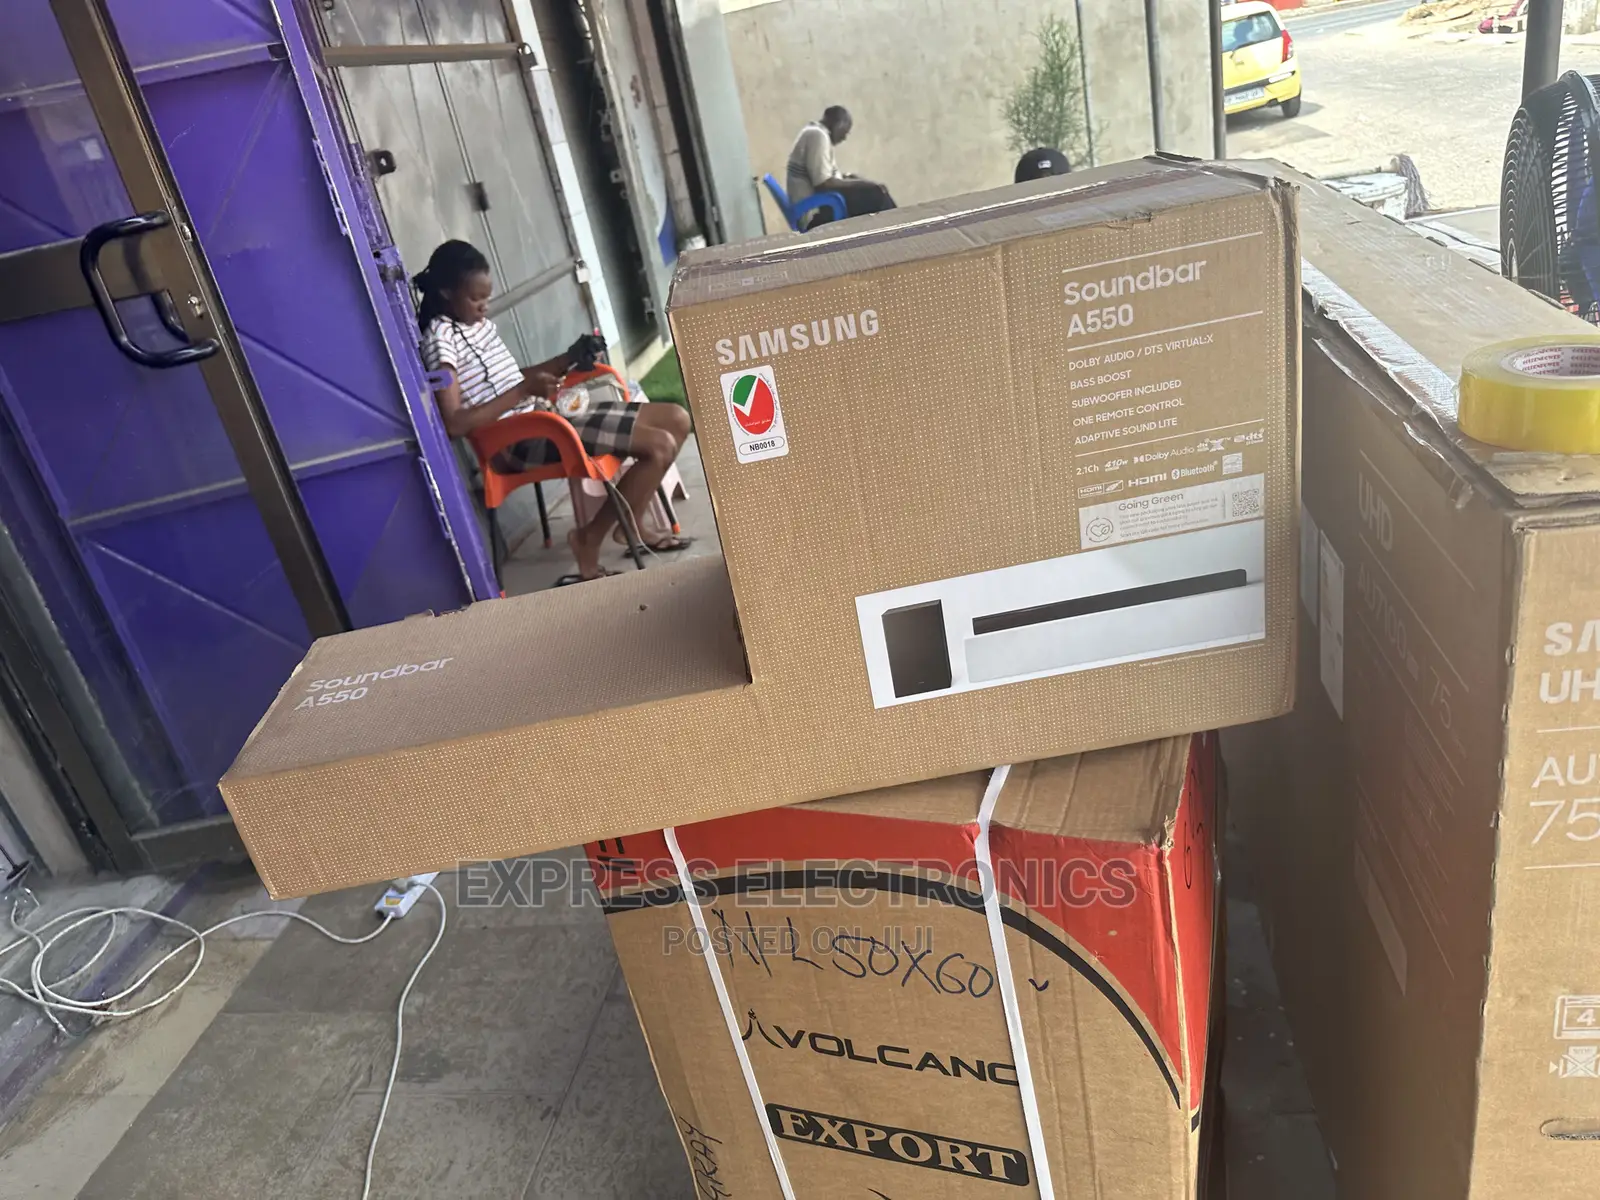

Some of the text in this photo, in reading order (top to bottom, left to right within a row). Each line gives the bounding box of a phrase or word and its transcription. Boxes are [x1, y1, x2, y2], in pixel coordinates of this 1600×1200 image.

[1064, 260, 1207, 305] Soundbar
[1067, 304, 1134, 338] A550
[715, 309, 880, 366] SAMSUNG
[1068, 356, 1101, 371] DOLBY
[1103, 350, 1135, 365] AUDIO
[1144, 345, 1163, 356] DTS
[1070, 370, 1133, 390] BASS BOOST
[1071, 379, 1182, 409] SUBWOOFER INCLUDED
[1073, 398, 1185, 427] ONE REMOTE CONTROL
[749, 439, 776, 452] NB0018
[1074, 417, 1178, 446] ADAPTIVE SOUND LITE
[1076, 464, 1100, 476] 2.1Ch
[1145, 451, 1170, 462] Dolby
[1170, 446, 1195, 458] Audio
[1128, 473, 1168, 488] HDMI
[1180, 463, 1215, 478] Bluetooth
[1118, 493, 1184, 511] Going Green
[1358, 471, 1393, 550] UHD
[306, 657, 454, 693] Soundbar
[294, 687, 369, 711] A550
[1531, 753, 1600, 788] AU
[775, 1107, 1018, 1181] EXPORT
